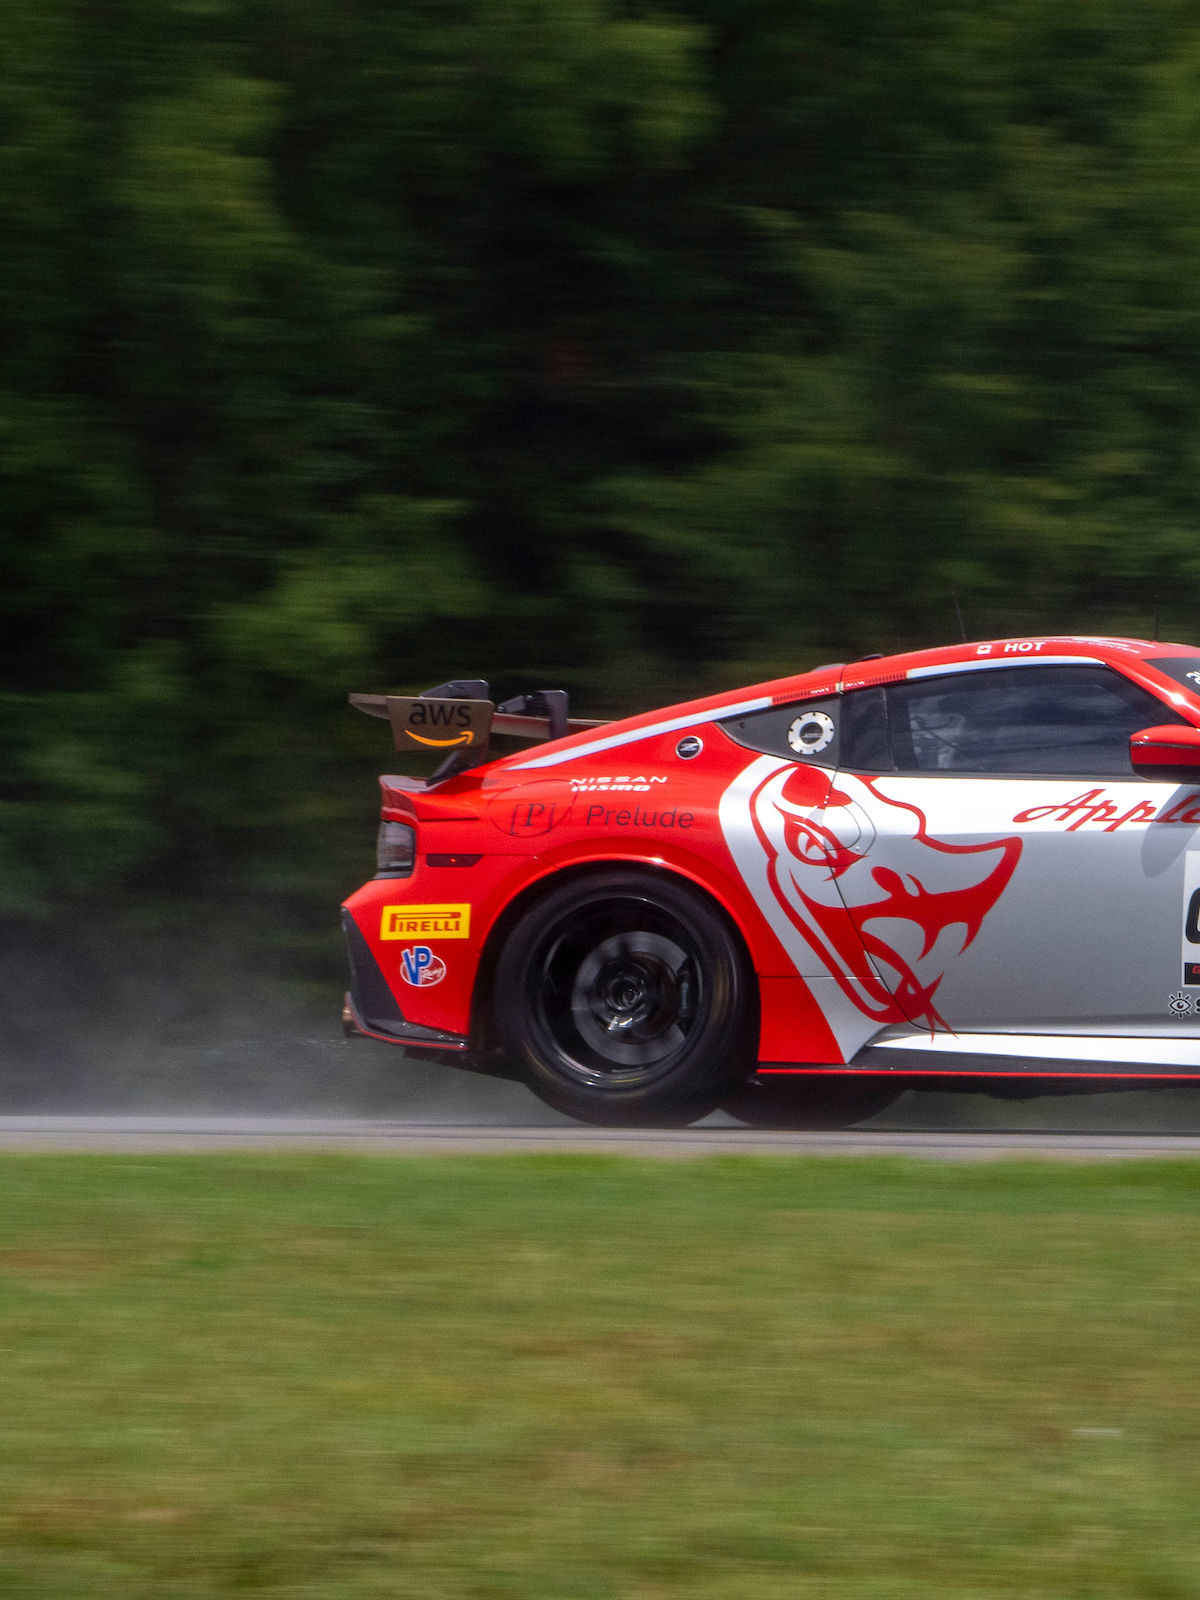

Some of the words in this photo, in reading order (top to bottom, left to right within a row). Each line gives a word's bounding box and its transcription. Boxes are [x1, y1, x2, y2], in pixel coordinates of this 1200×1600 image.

[1004, 642, 1046, 652] HOT
[409, 702, 471, 727] aws
[570, 776, 668, 785] NISSAN
[571, 784, 651, 792] nismo
[586, 805, 695, 829] Prelude
[389, 912, 461, 932] PIRELLI
[401, 946, 433, 986] VP
